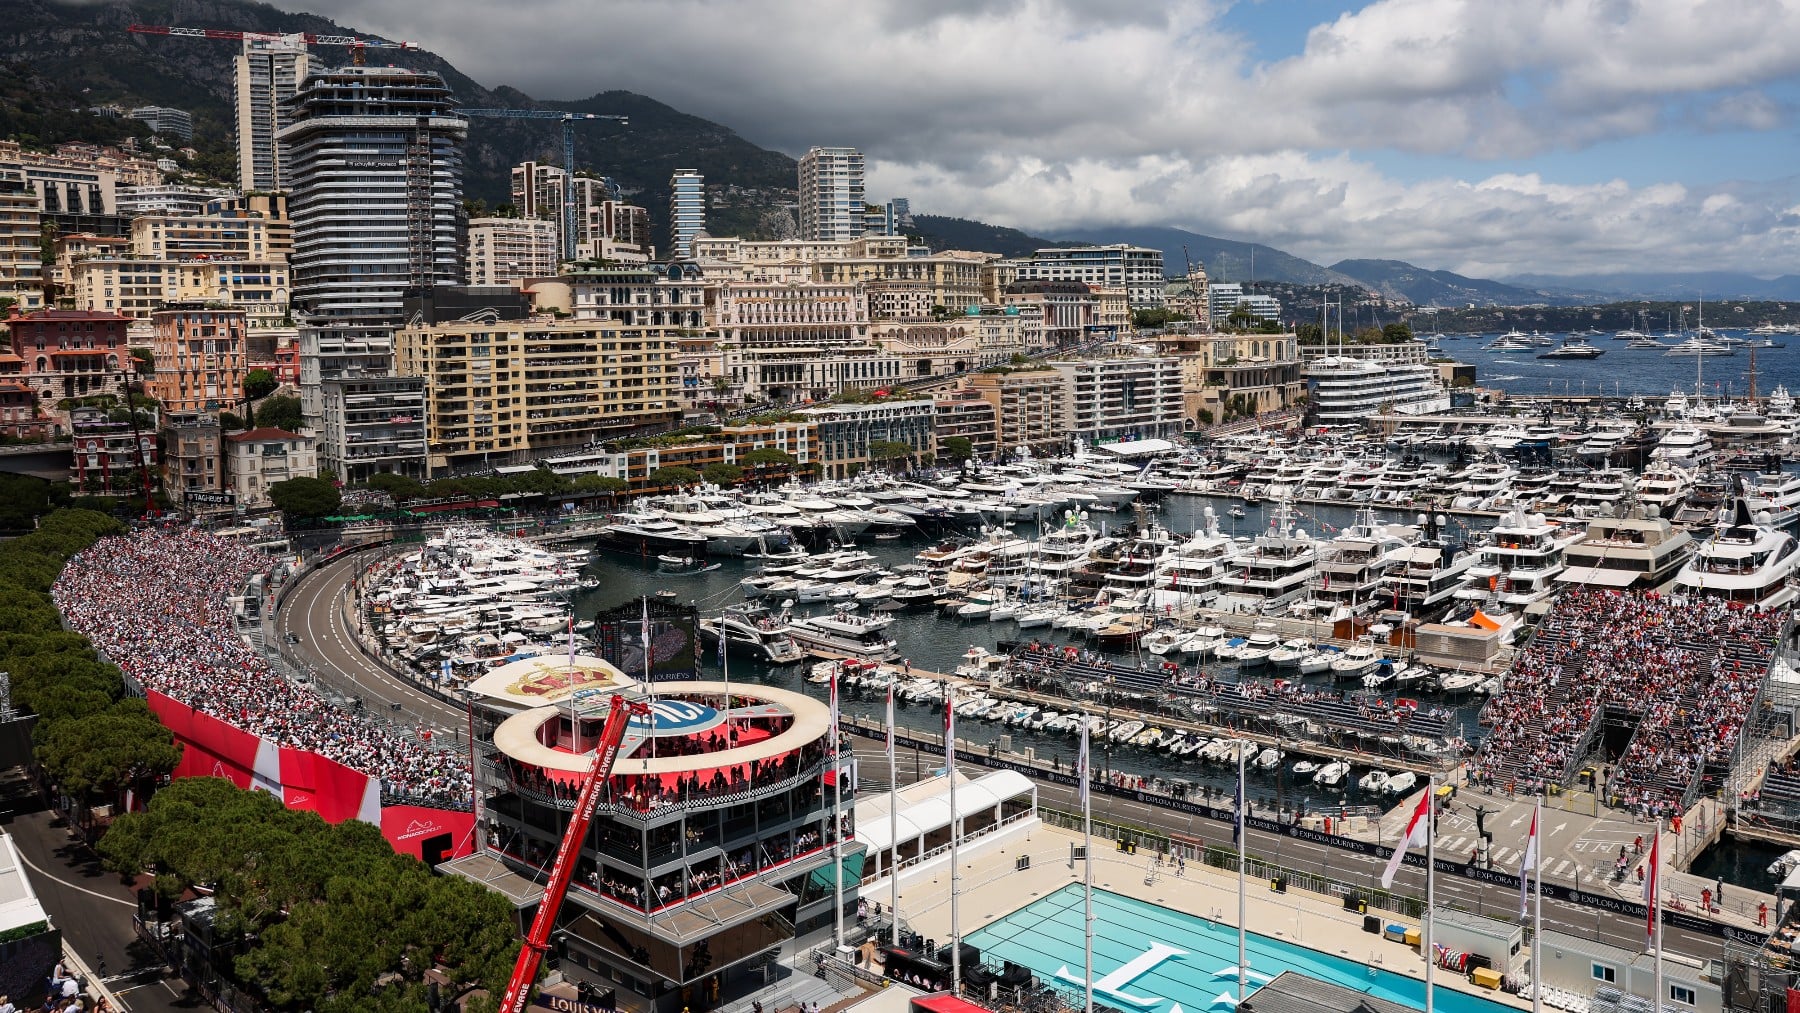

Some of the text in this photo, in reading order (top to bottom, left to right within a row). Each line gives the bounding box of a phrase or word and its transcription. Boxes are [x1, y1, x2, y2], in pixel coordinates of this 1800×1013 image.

[654, 672, 690, 681] JOURNEYS
[582, 745, 616, 821] IMPERIAL LEVAGE
[1145, 795, 1201, 814] EXPLORA JOURNEYS
[1247, 818, 1280, 832] JOURNEYS
[1299, 830, 1365, 851] EXPLORA JOURNEYS
[1385, 850, 1455, 872] EXORA JORNEYS
[1476, 870, 1513, 885] EXPLORA
[1581, 894, 1666, 920] EXPLORA JOURNS
[1737, 931, 1767, 944] EXPLO
[513, 983, 530, 1013] EVAGE
[551, 996, 590, 1013] LOUIS
